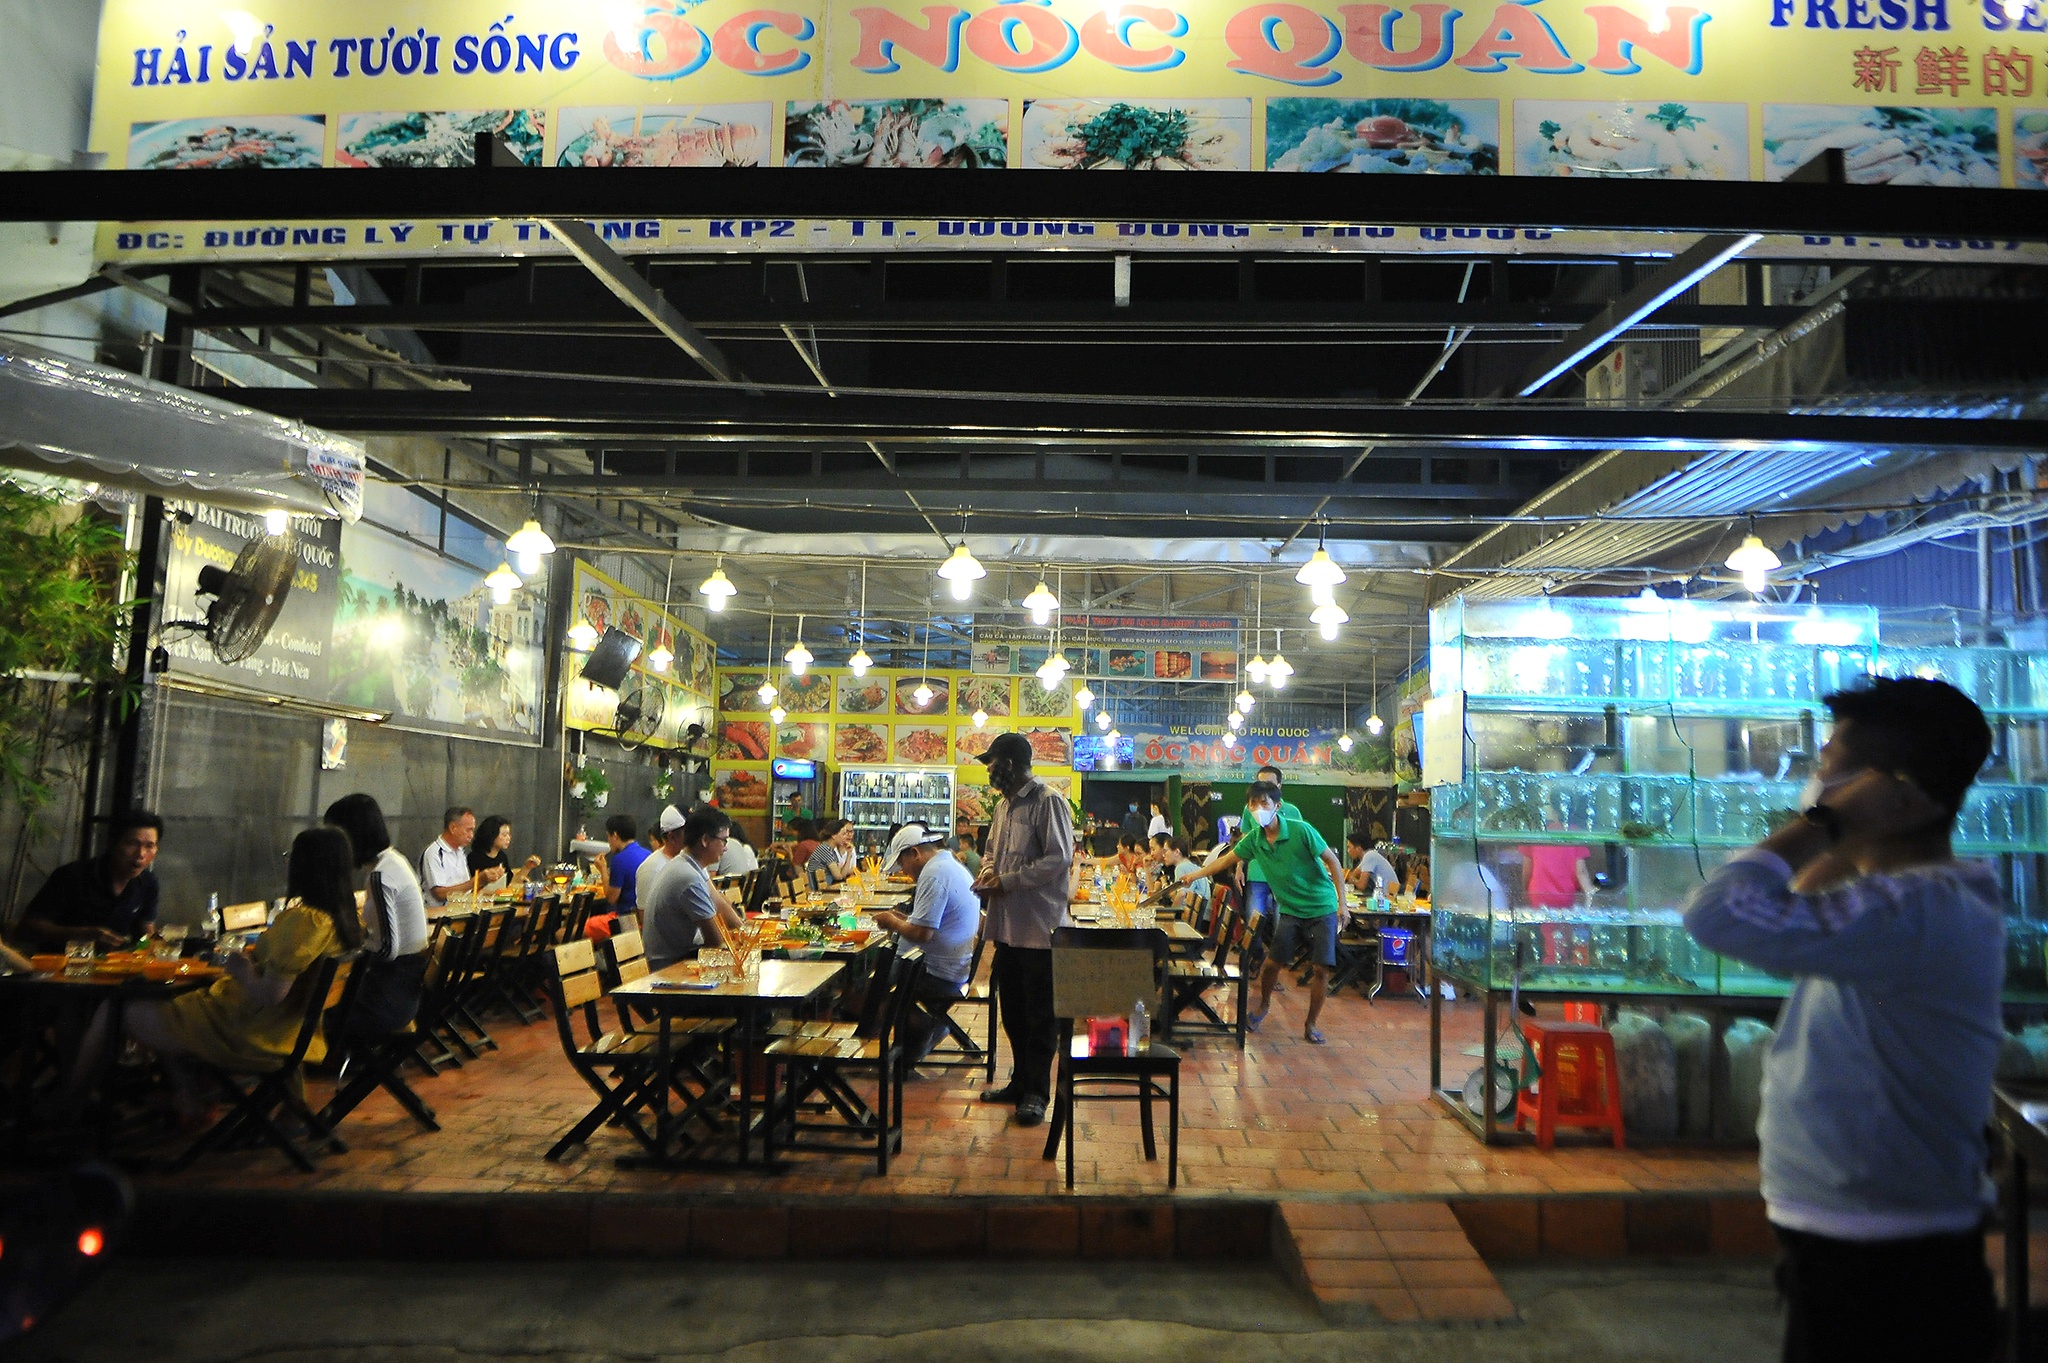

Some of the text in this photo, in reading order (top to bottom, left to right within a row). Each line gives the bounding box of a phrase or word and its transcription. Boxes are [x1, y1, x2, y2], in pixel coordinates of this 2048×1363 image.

[1769, 0, 1951, 31] FRESH
[131, 15, 580, 87] HẢI SẢN TƯƠI SỐNG
[1852, 46, 2048, 97] 新鲜的
[364, 221, 415, 244] LÝ
[436, 222, 494, 245] TỰ
[708, 219, 796, 239] KP2
[1276, 728, 1310, 738] QUOC
